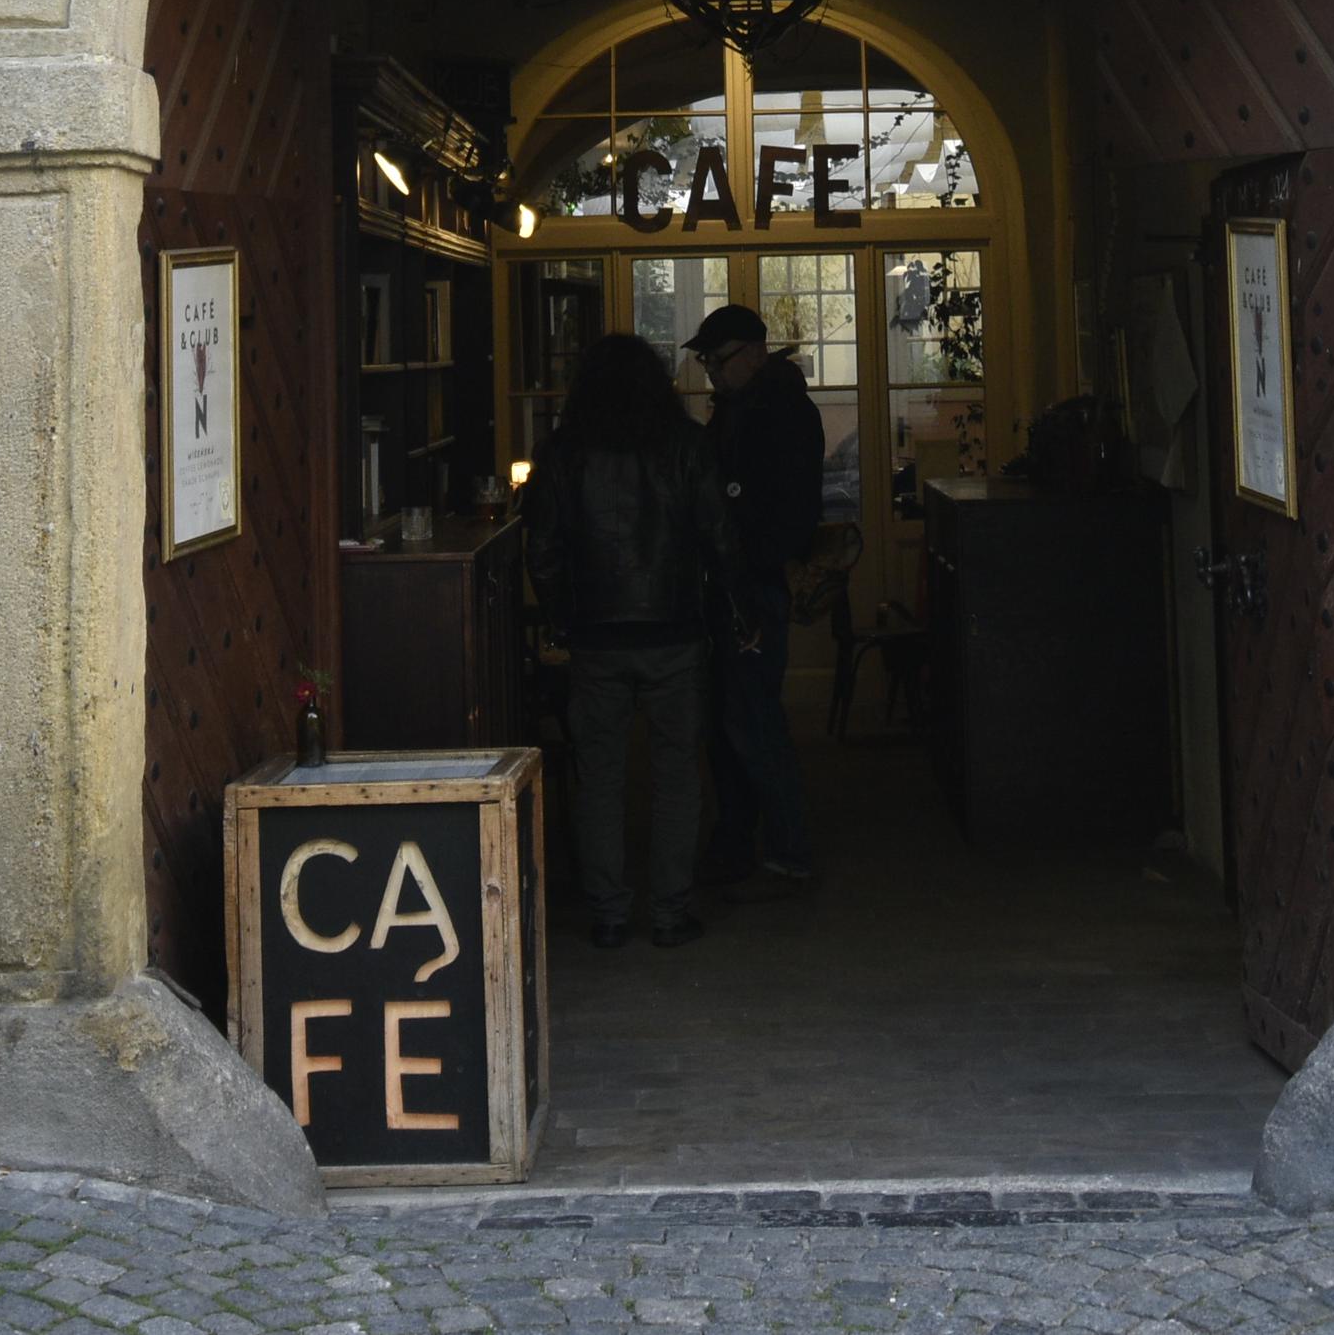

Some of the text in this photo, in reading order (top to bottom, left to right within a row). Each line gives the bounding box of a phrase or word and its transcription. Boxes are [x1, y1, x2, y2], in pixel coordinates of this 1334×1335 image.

[620, 143, 862, 234] CAFE
[184, 298, 215, 323] CAFÉ
[194, 394, 208, 439] N
